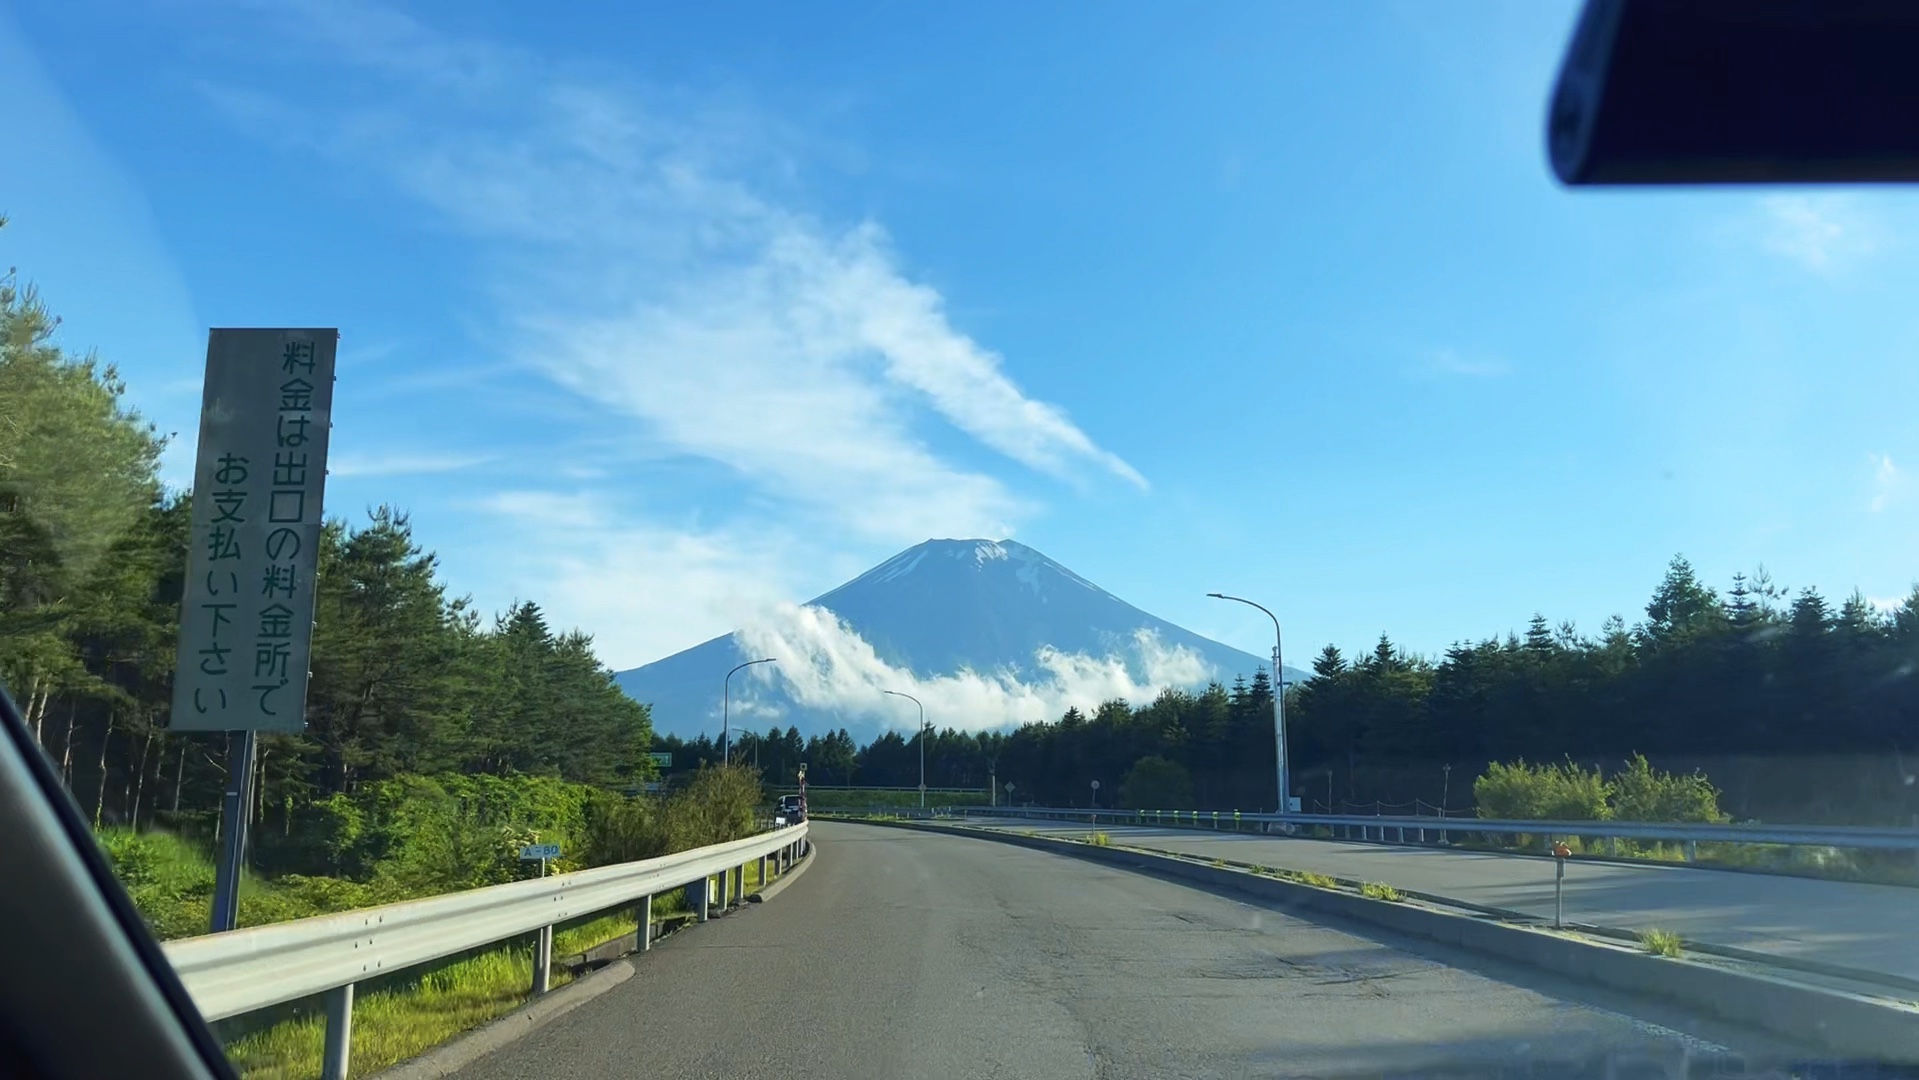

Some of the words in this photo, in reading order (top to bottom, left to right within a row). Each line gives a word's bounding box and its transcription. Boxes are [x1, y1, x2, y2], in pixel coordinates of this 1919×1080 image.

[194, 452, 250, 714] お支払い下さい
[252, 341, 316, 716] 料金は出口の料金所で
